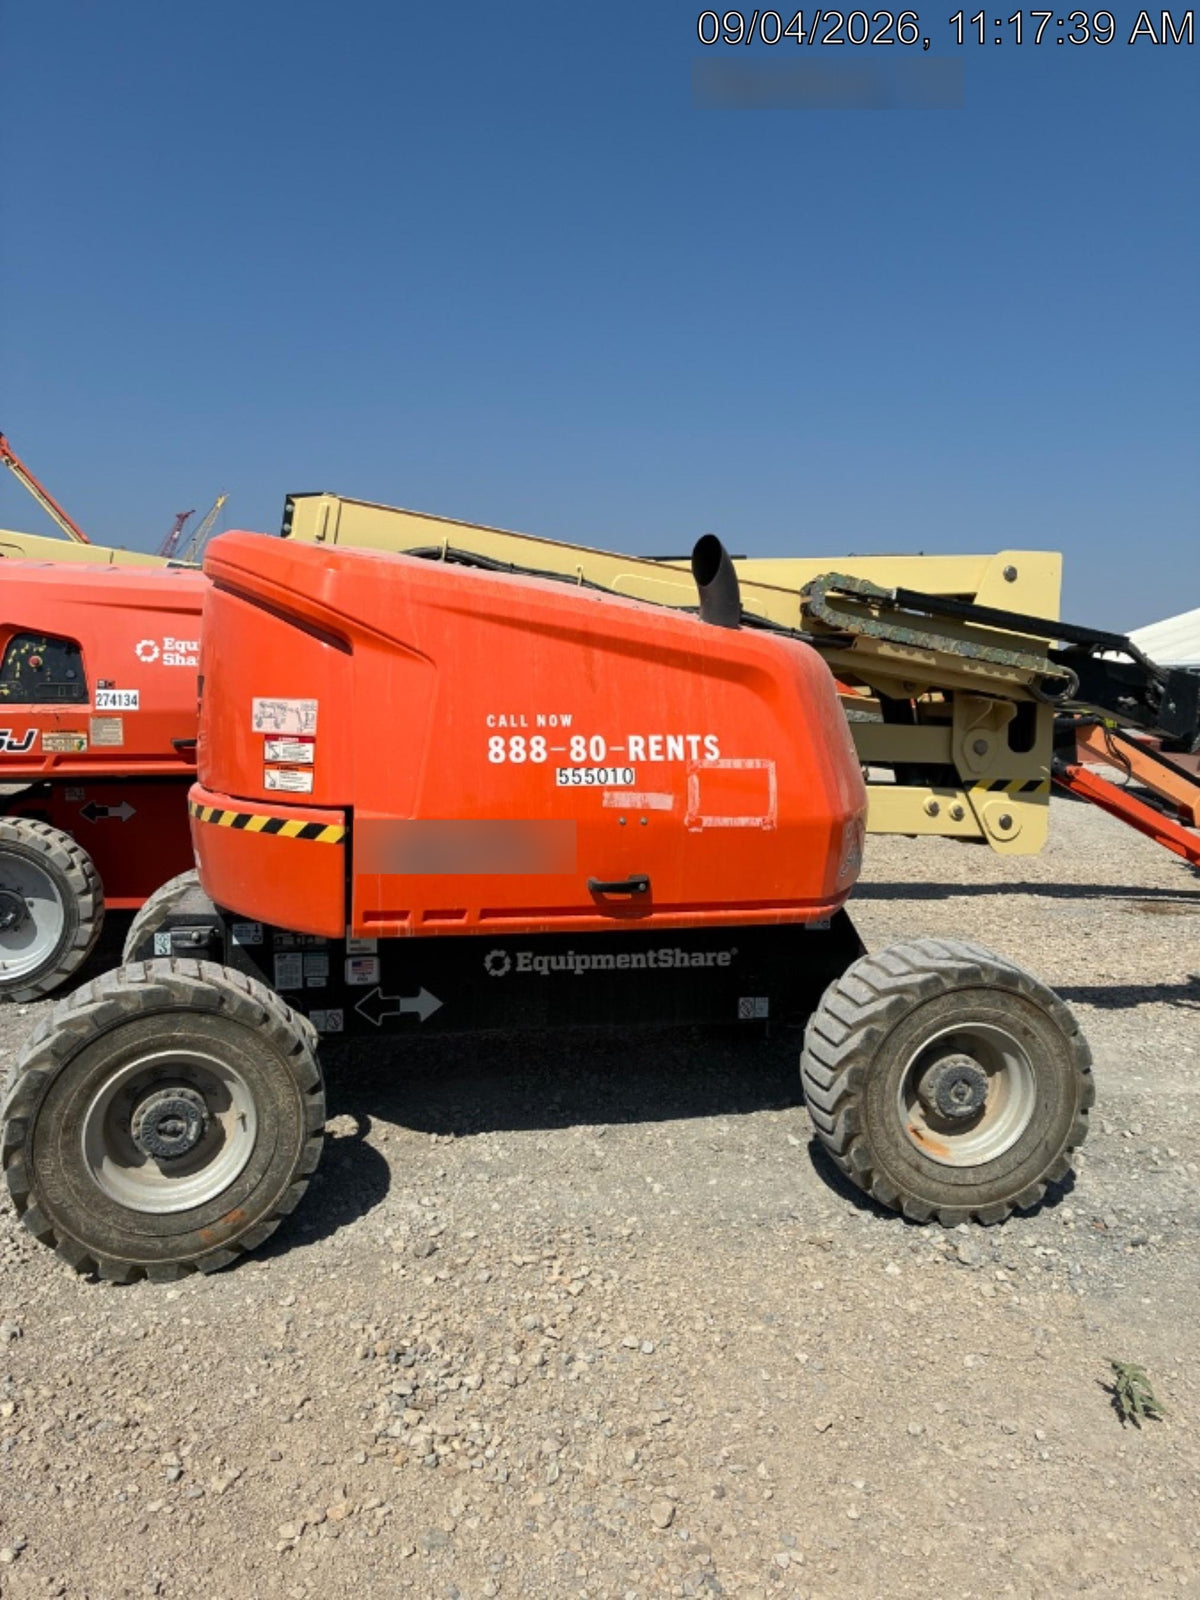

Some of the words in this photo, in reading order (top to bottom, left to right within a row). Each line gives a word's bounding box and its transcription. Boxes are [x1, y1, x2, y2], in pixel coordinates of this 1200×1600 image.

[163, 637, 200, 655] Equ
[163, 653, 199, 667] Sha
[96, 692, 138, 708] 274134
[486, 714, 528, 728] CALL
[537, 714, 573, 727] NOW
[488, 734, 720, 763] 888-80-RENTS
[558, 767, 635, 785] 555010
